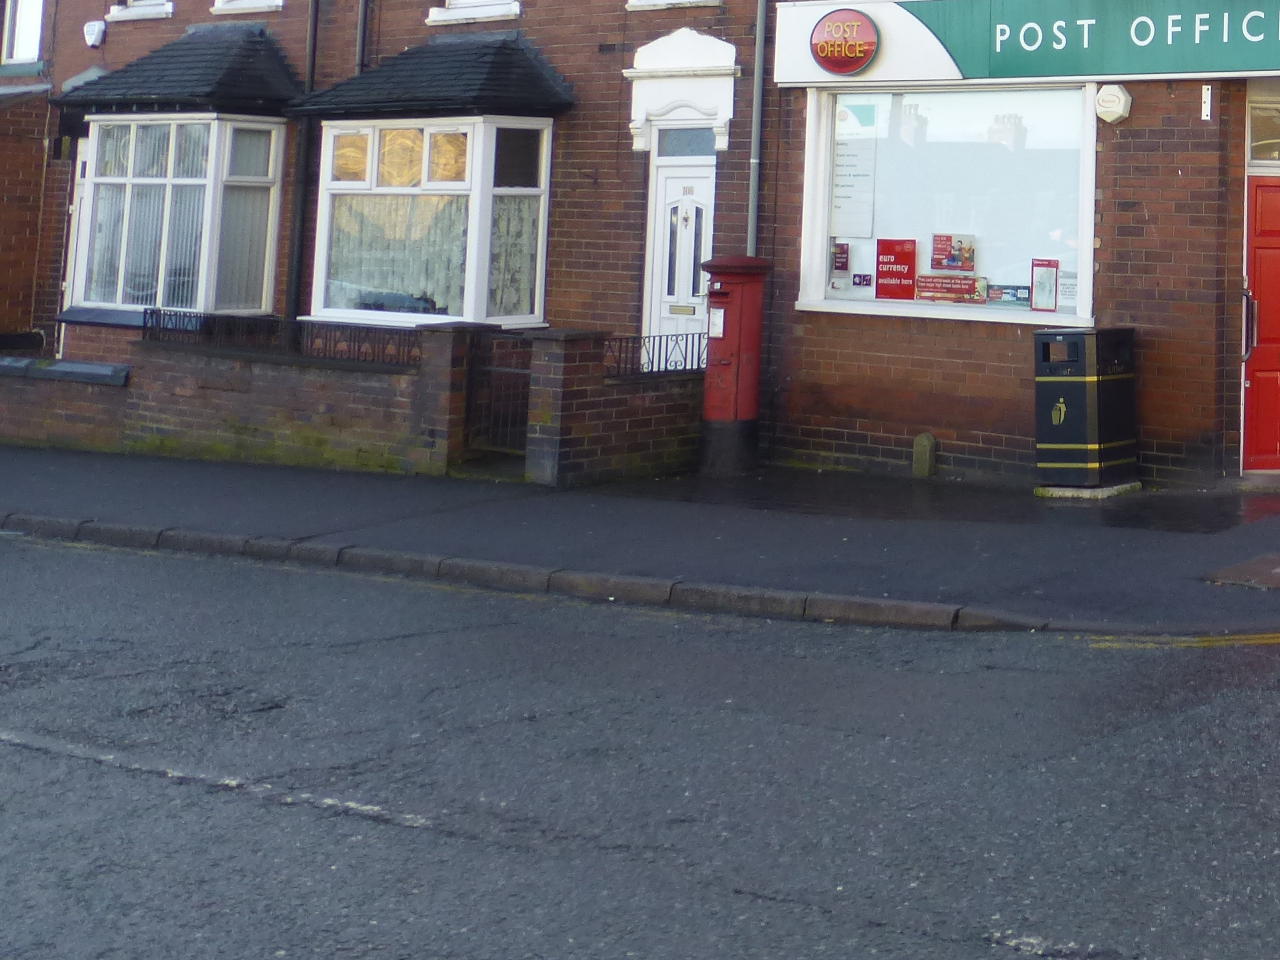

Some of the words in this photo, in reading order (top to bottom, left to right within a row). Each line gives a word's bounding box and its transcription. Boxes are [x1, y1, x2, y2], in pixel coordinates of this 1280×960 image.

[824, 21, 862, 38] POST
[996, 19, 1096, 53] POST
[817, 41, 865, 58] OFFICE
[878, 264, 909, 274] currency
